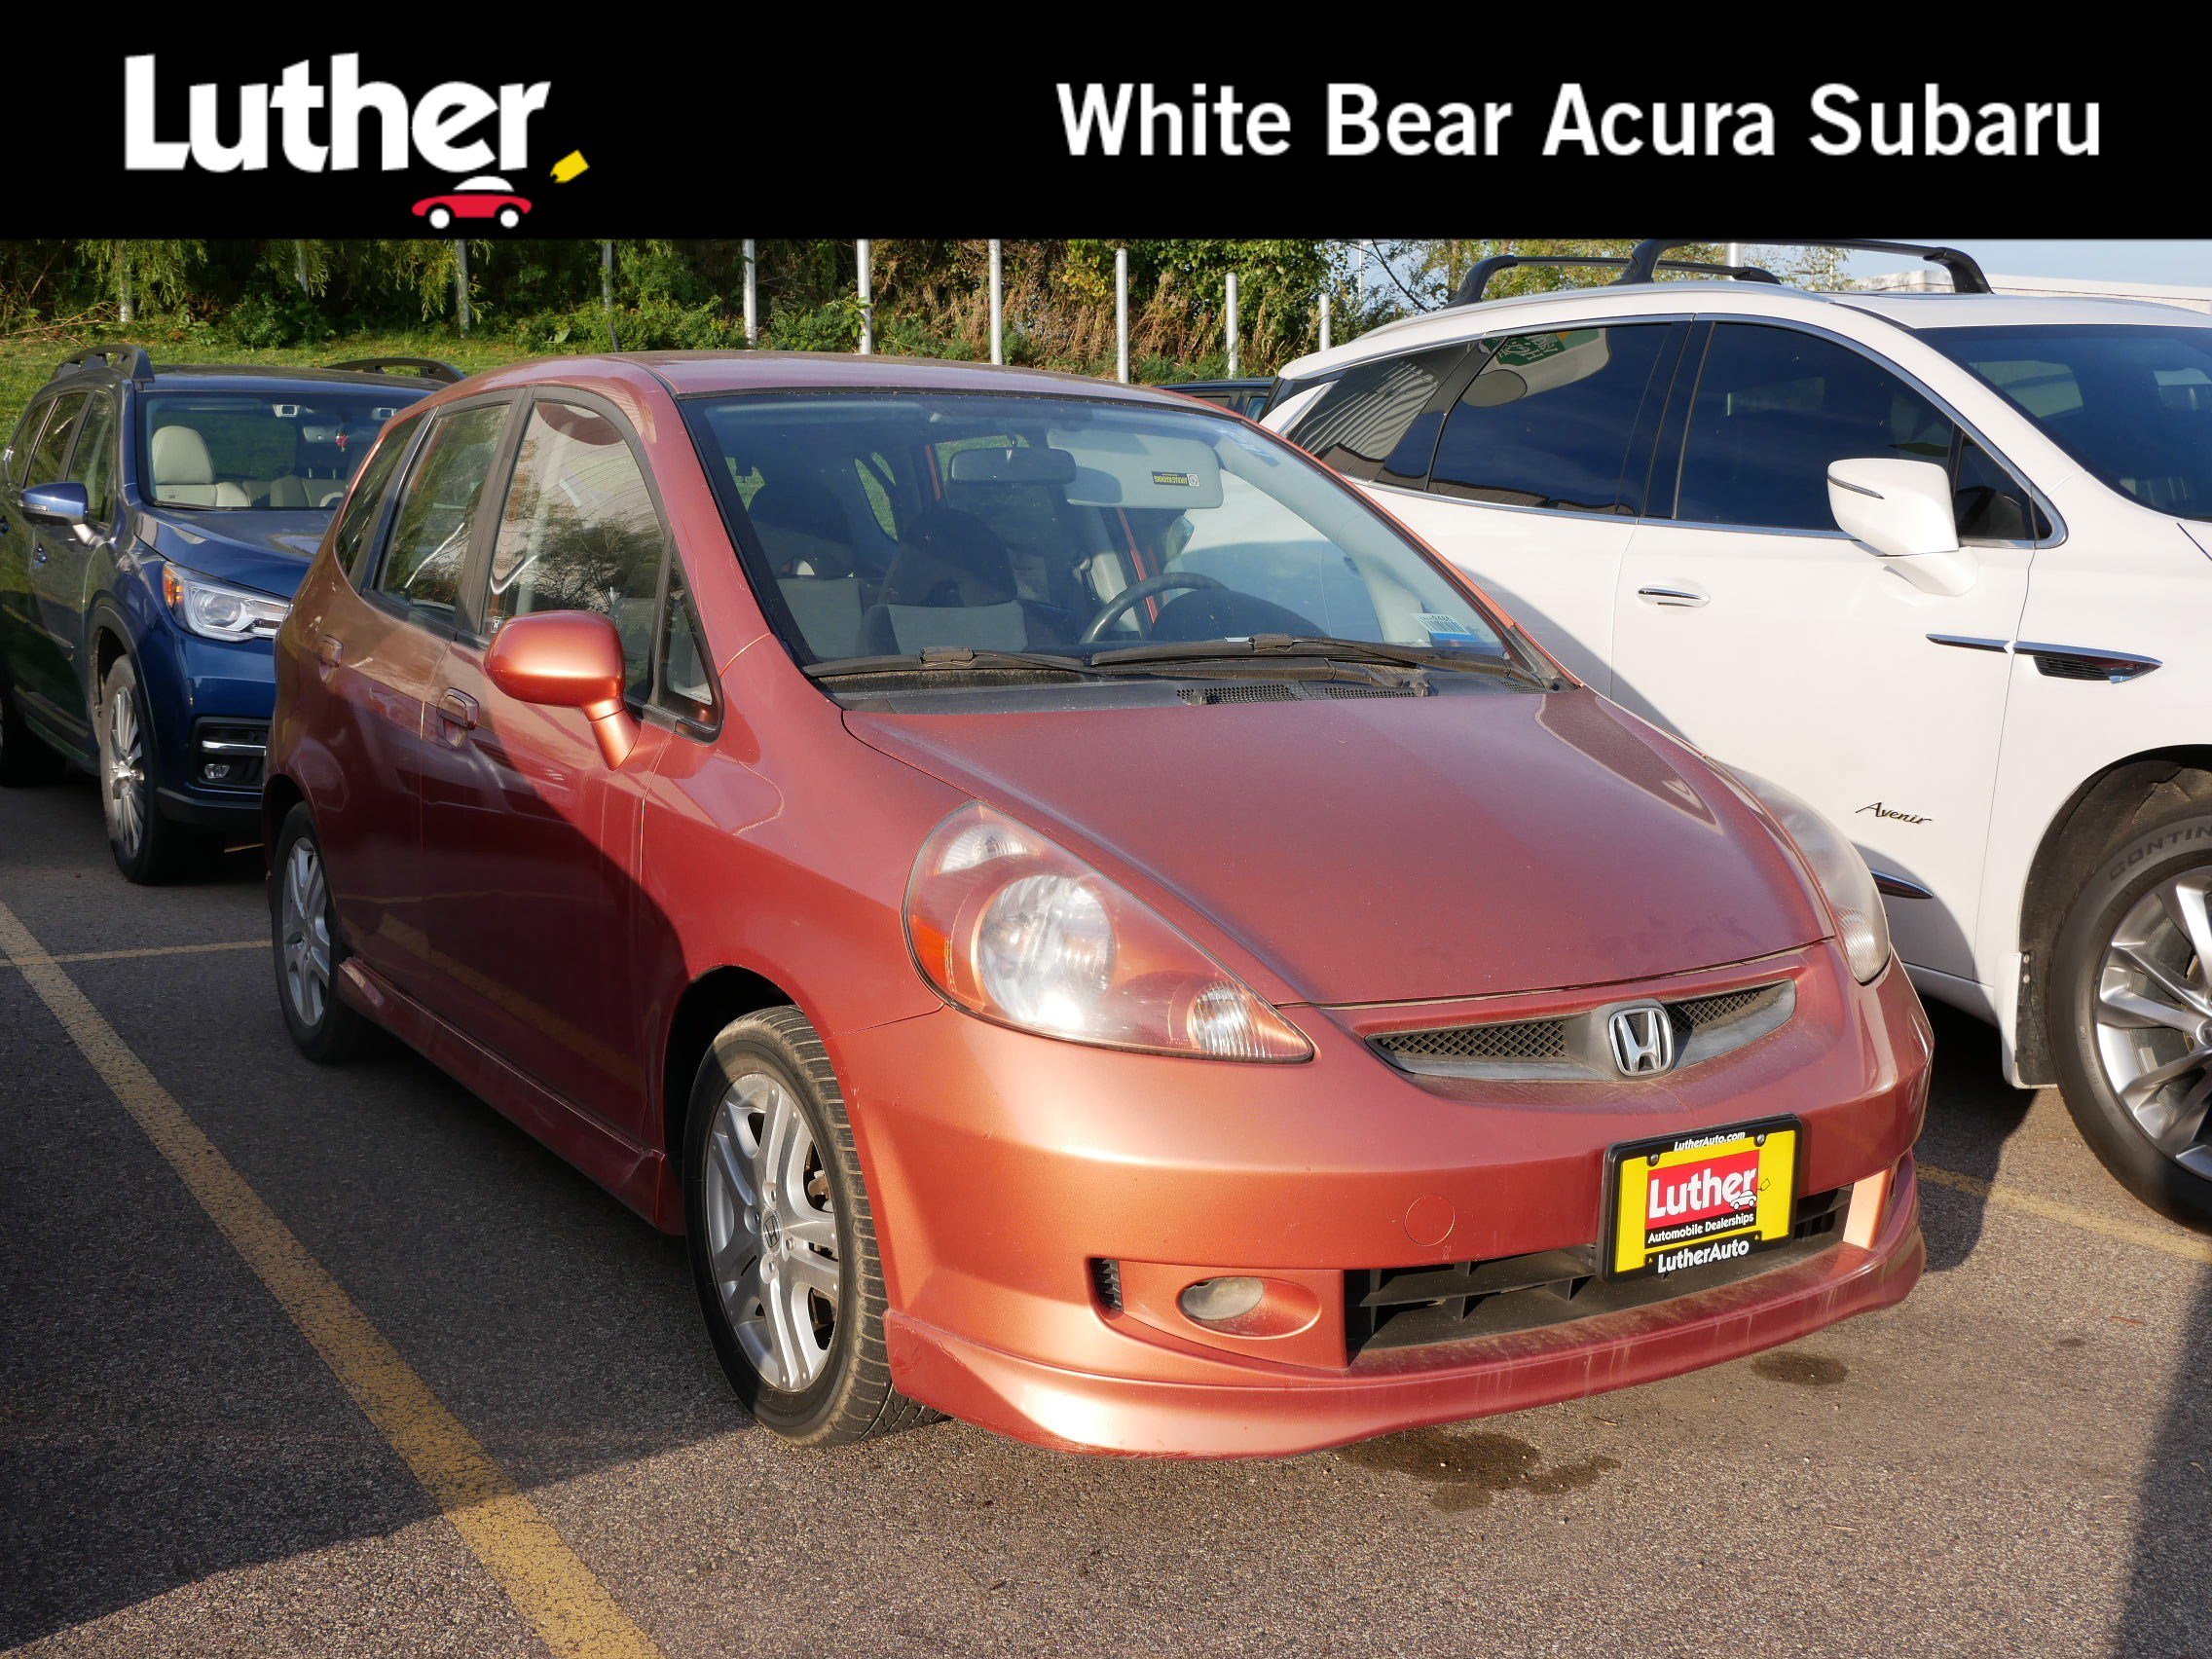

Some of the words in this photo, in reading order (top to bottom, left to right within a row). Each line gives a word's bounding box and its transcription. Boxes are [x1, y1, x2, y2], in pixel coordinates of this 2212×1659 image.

[1855, 801, 1933, 825] Avenir
[1673, 1130, 1746, 1152] LutherAuto.com
[1648, 1166, 1757, 1220] Luther
[1647, 1223, 1704, 1244] Automobile
[1705, 1212, 1754, 1234] Dealerships
[1657, 1237, 1750, 1274] LutherAuto
